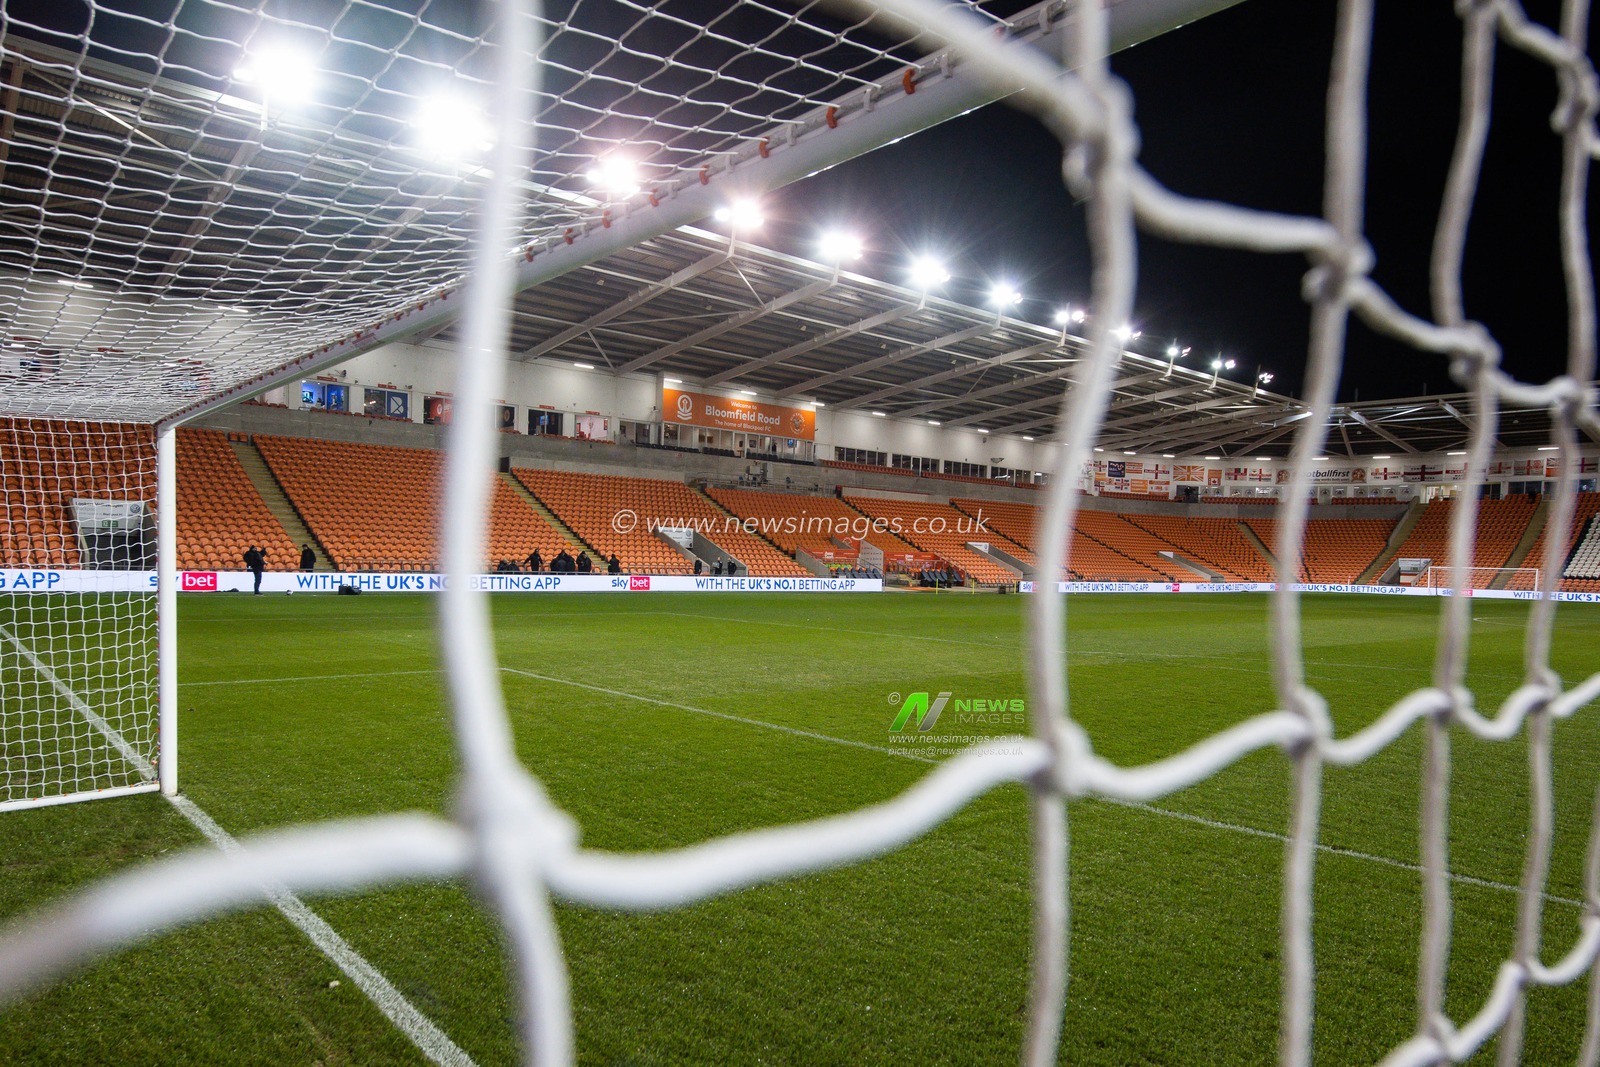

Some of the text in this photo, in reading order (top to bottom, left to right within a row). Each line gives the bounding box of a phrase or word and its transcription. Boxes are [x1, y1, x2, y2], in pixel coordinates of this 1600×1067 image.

[731, 401, 751, 409] Welcome
[705, 405, 755, 422] Bloomfield
[758, 412, 780, 425] Road
[743, 424, 764, 432] Blackpool
[13, 572, 60, 589] APP
[185, 574, 214, 587] bet
[297, 575, 343, 589] WITH
[348, 576, 382, 590] THE
[387, 575, 425, 590] UK'S
[534, 577, 561, 590] APP
[611, 577, 649, 589] sky bet
[695, 578, 856, 591] WITH THE UK'S NO.1 BETTING APP
[1080, 583, 1091, 591] THE
[1091, 583, 1104, 592] UK'S
[1105, 583, 1117, 591] NO.1
[1117, 583, 1139, 591] BETTING
[1139, 583, 1150, 591] APP
[1350, 586, 1387, 594] BETTING
[1513, 591, 1540, 599] WITH
[1566, 593, 1592, 601] UK'S
